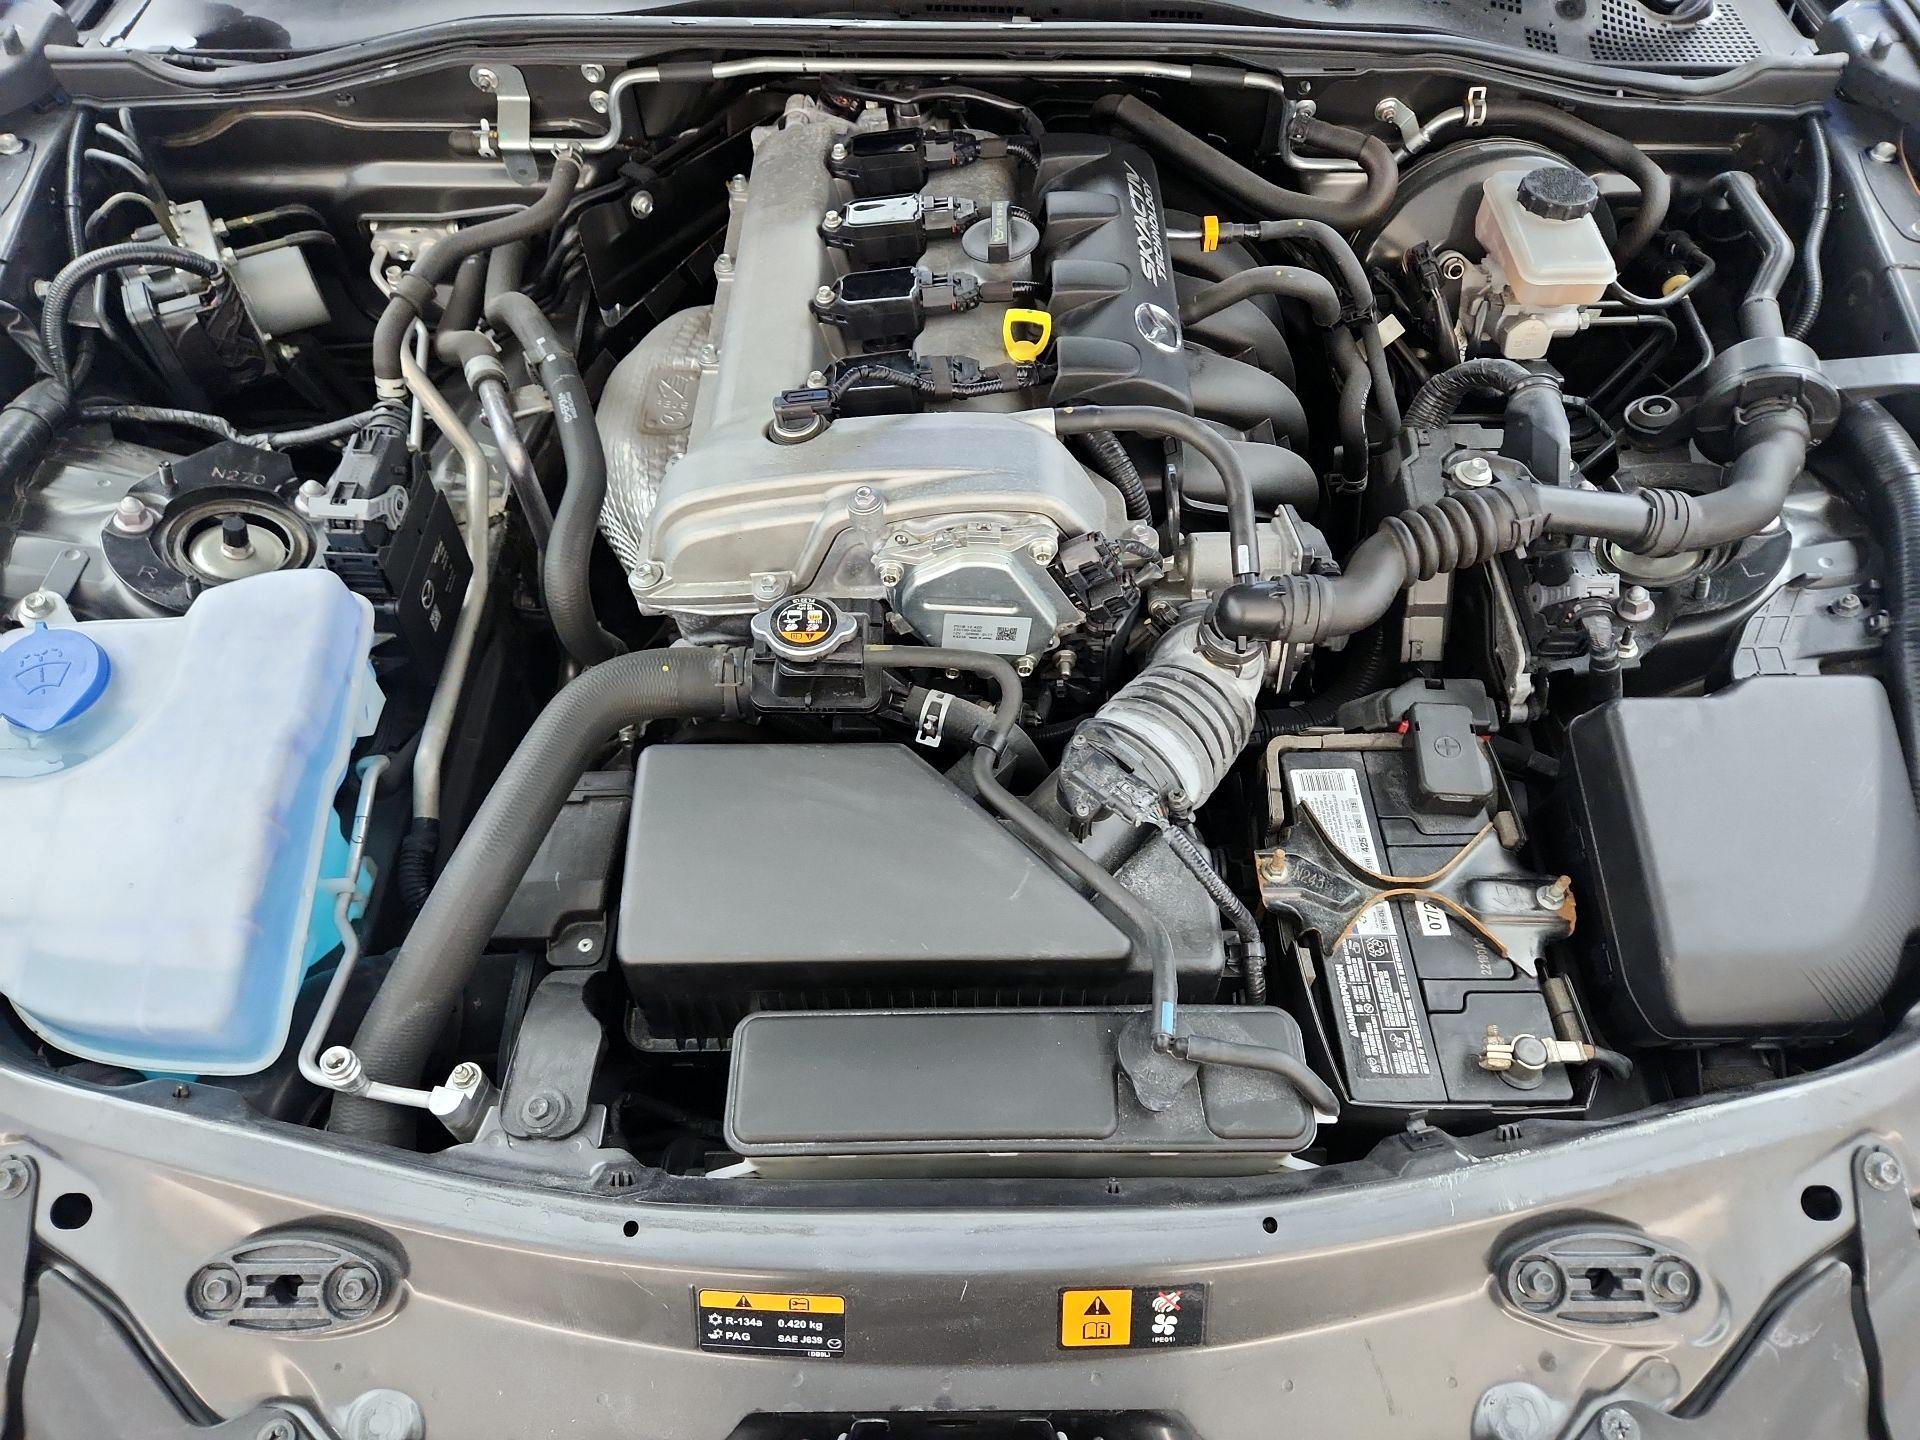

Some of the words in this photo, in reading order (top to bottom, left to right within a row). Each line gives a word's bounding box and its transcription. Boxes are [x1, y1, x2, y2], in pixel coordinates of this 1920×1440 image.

[1124, 160, 1158, 287] SKYACTIV
[1142, 177, 1167, 281] TECHNOLOGY
[211, 466, 266, 485] N270
[138, 566, 159, 579] R
[1360, 837, 1369, 853] 425
[726, 1317, 763, 1327] R-134a
[778, 1319, 806, 1328] 0.420
[809, 1320, 823, 1331] kg
[726, 1331, 751, 1341] PAG
[778, 1334, 798, 1343] SAE
[801, 1335, 823, 1344] J639
